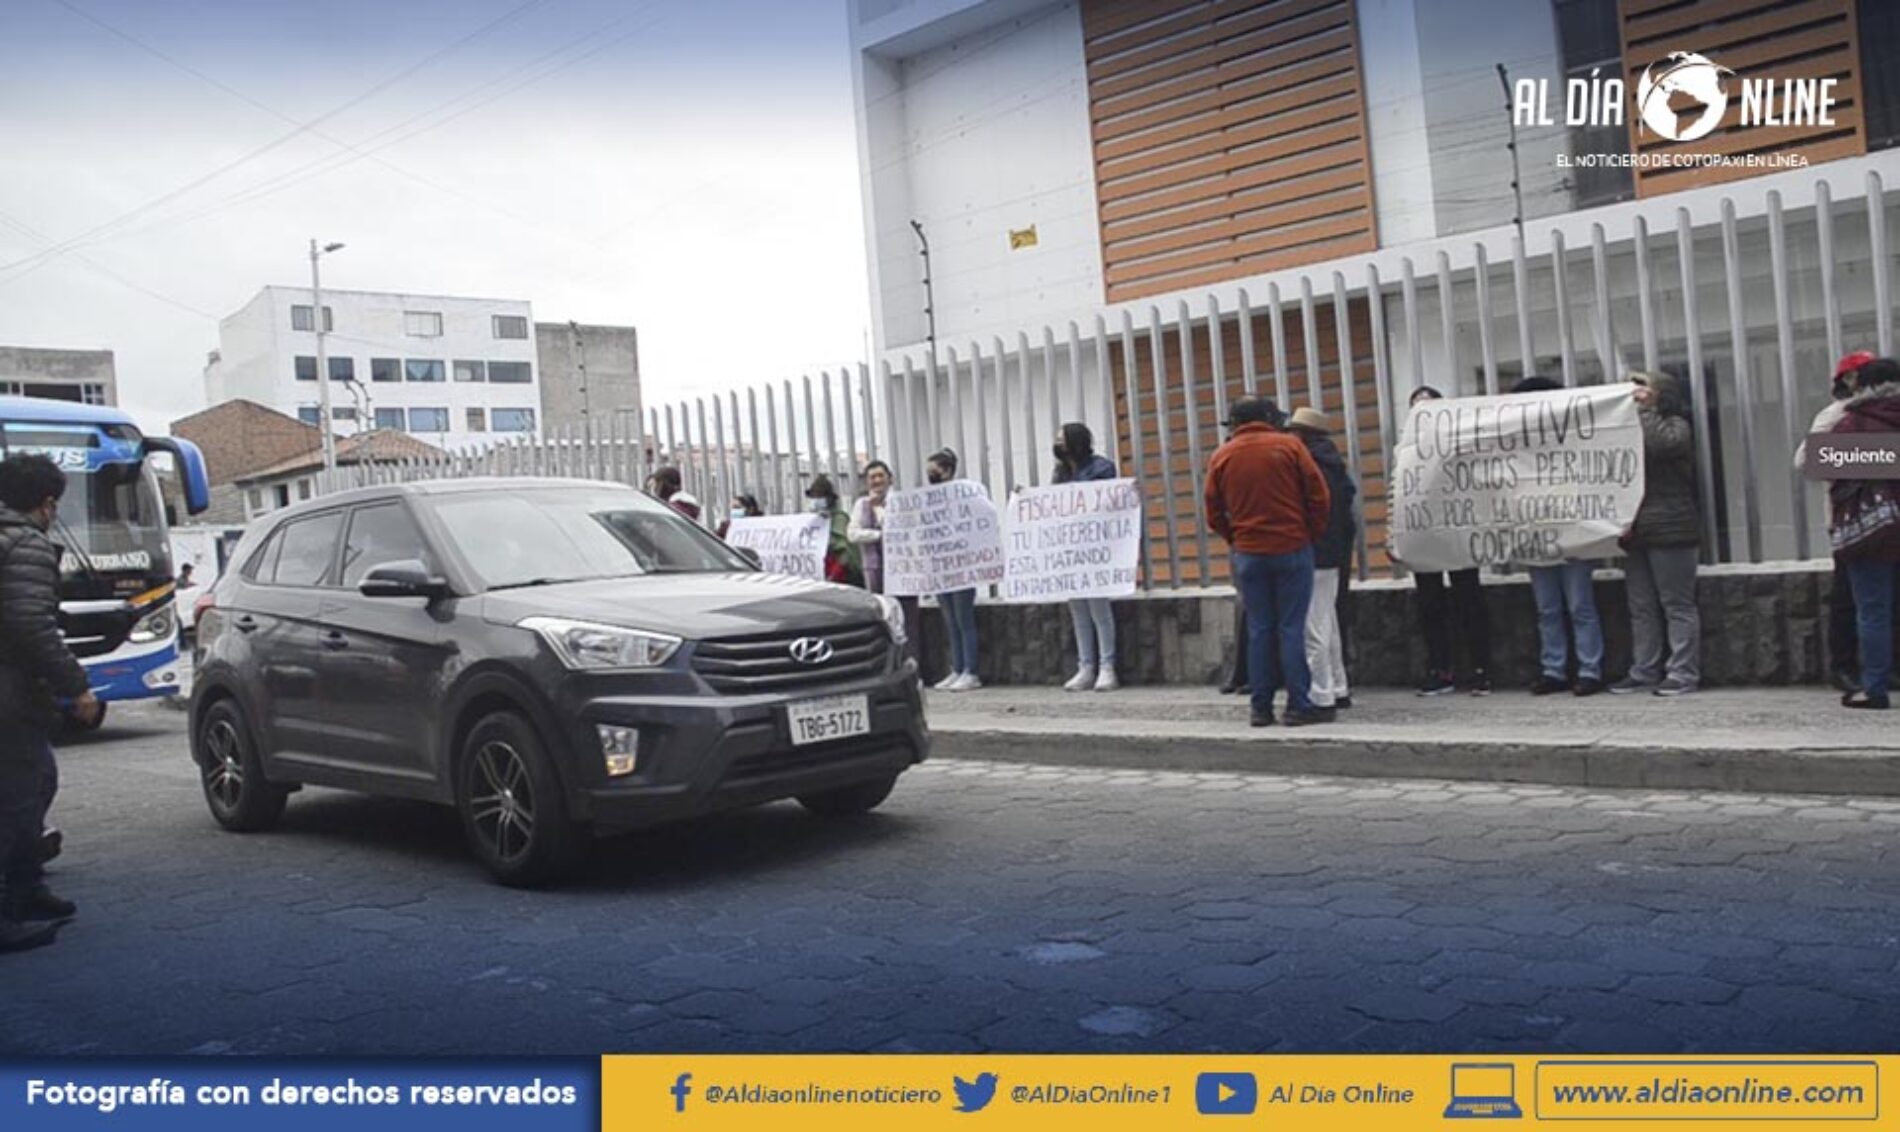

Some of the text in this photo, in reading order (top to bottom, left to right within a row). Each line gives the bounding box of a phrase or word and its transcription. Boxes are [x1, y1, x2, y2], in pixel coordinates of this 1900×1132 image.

[1415, 394, 1596, 460] COLECTIVO
[1403, 465, 1427, 496] DE
[1442, 454, 1518, 494] SOCIOS
[1443, 498, 1478, 527] POR
[1492, 497, 1512, 522] LA
